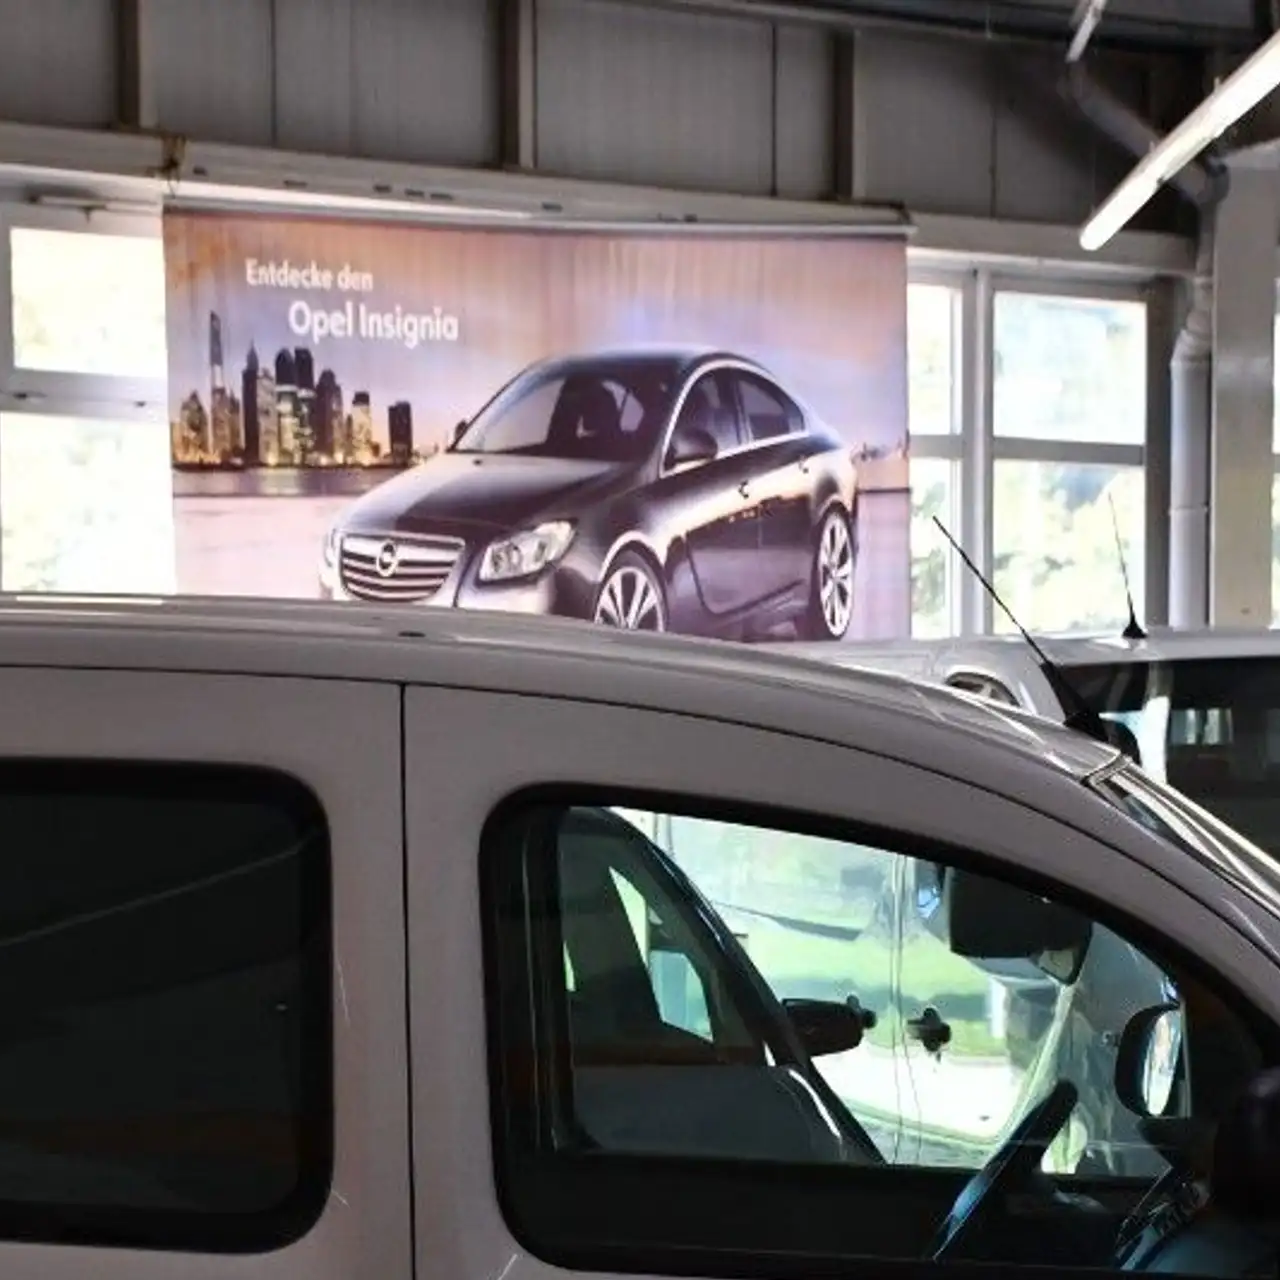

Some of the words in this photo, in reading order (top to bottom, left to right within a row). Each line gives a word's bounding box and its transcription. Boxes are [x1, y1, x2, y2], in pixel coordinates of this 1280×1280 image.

[245, 258, 333, 291] Entdecke
[337, 262, 373, 291] den
[288, 300, 353, 344] Opel
[359, 302, 458, 349] Insignia
